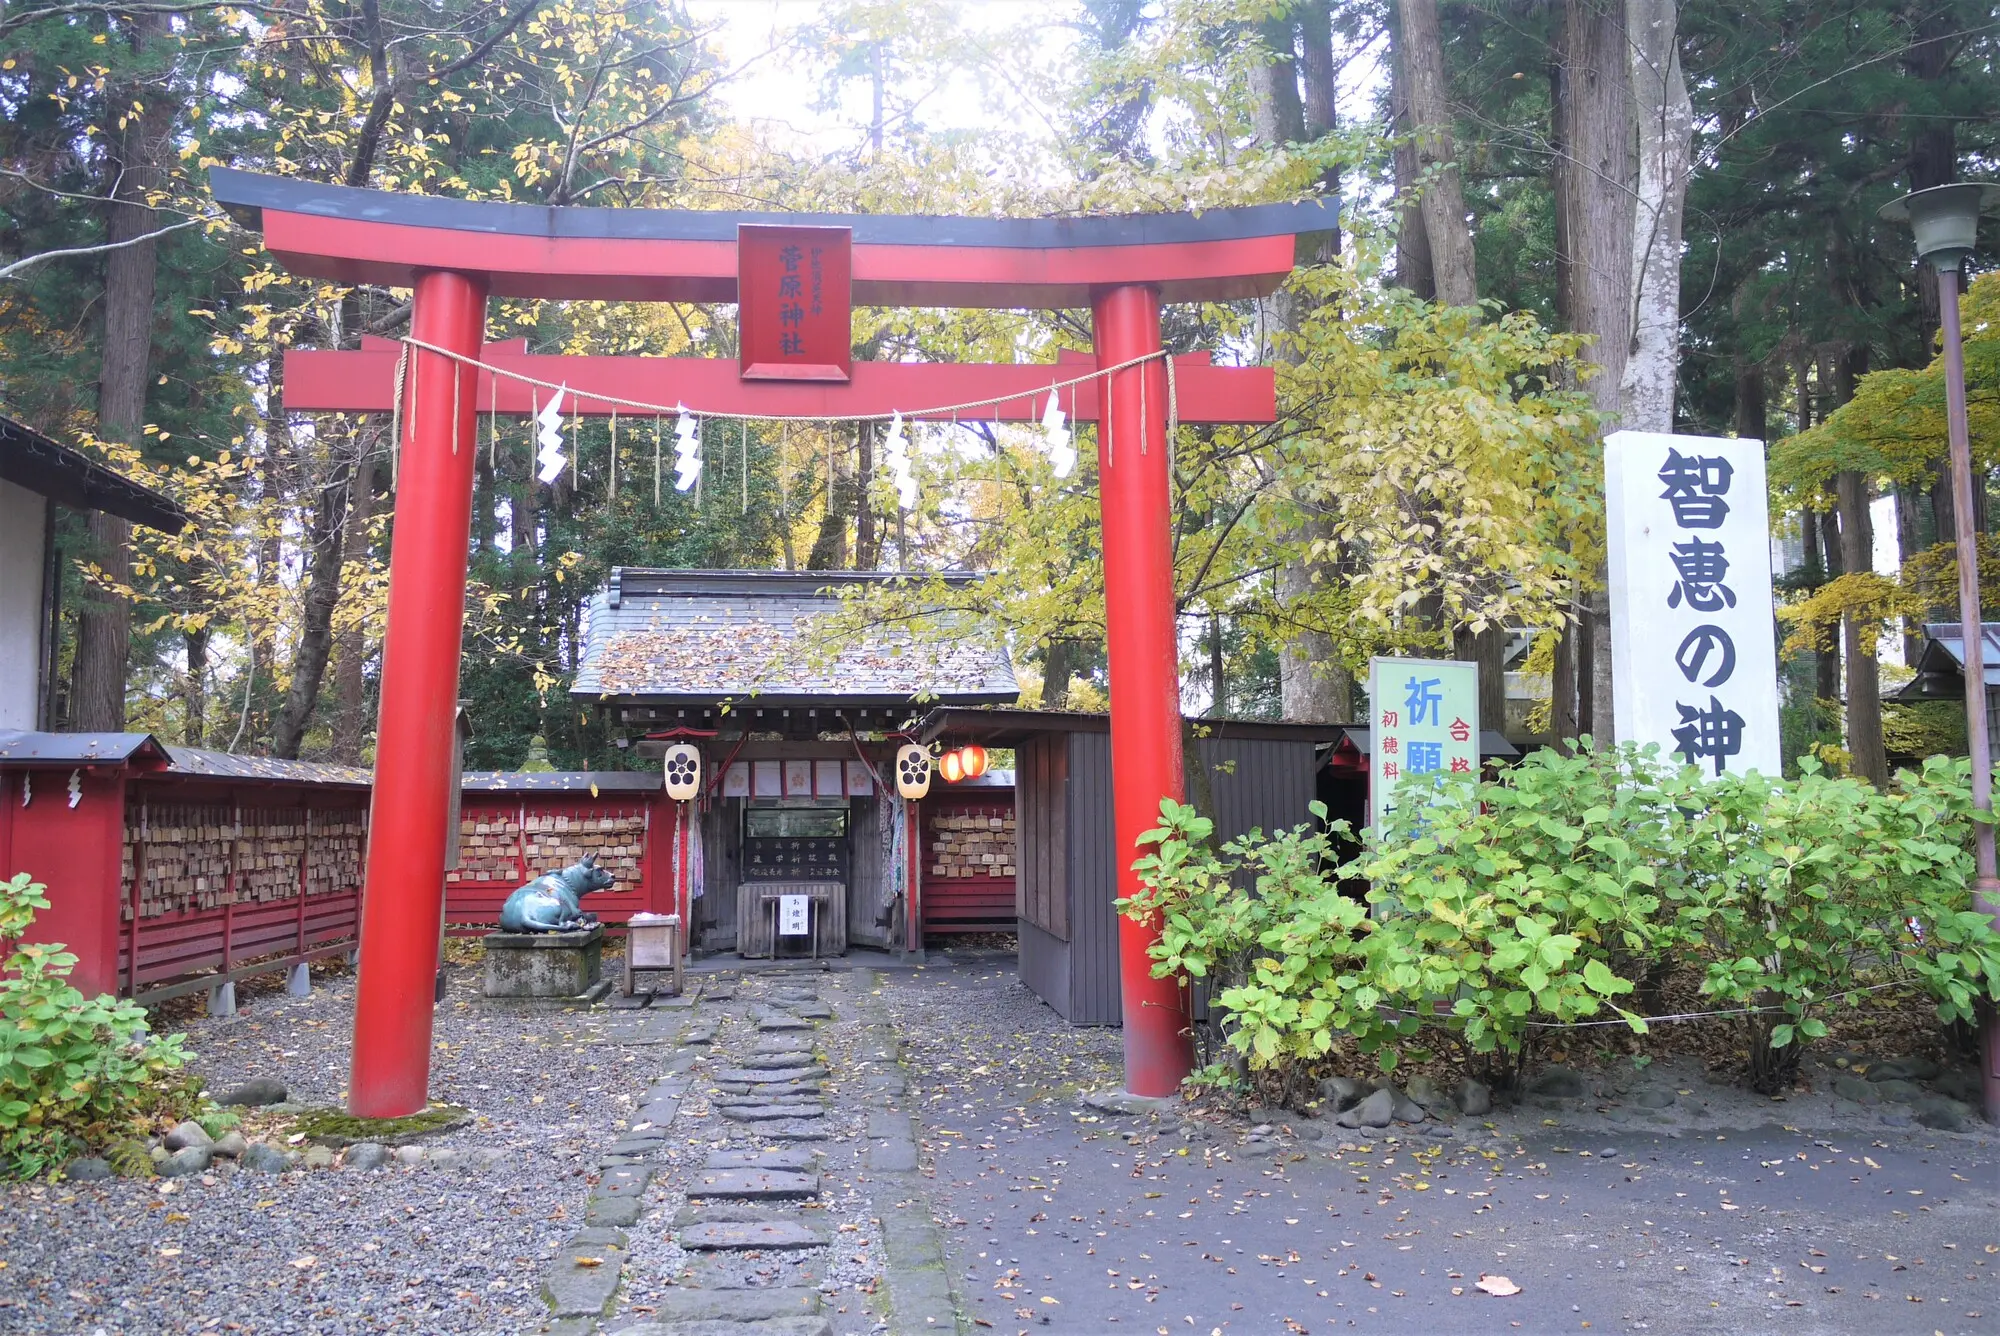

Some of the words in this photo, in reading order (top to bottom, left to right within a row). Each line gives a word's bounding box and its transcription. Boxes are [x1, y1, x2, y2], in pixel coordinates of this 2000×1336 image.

[778, 245, 805, 356] 菅原神社
[1658, 447, 1746, 820] 智恵の神
[1381, 709, 1399, 780] 初穂料
[1404, 676, 1444, 836] 祈願
[1448, 717, 1471, 774] 合格
